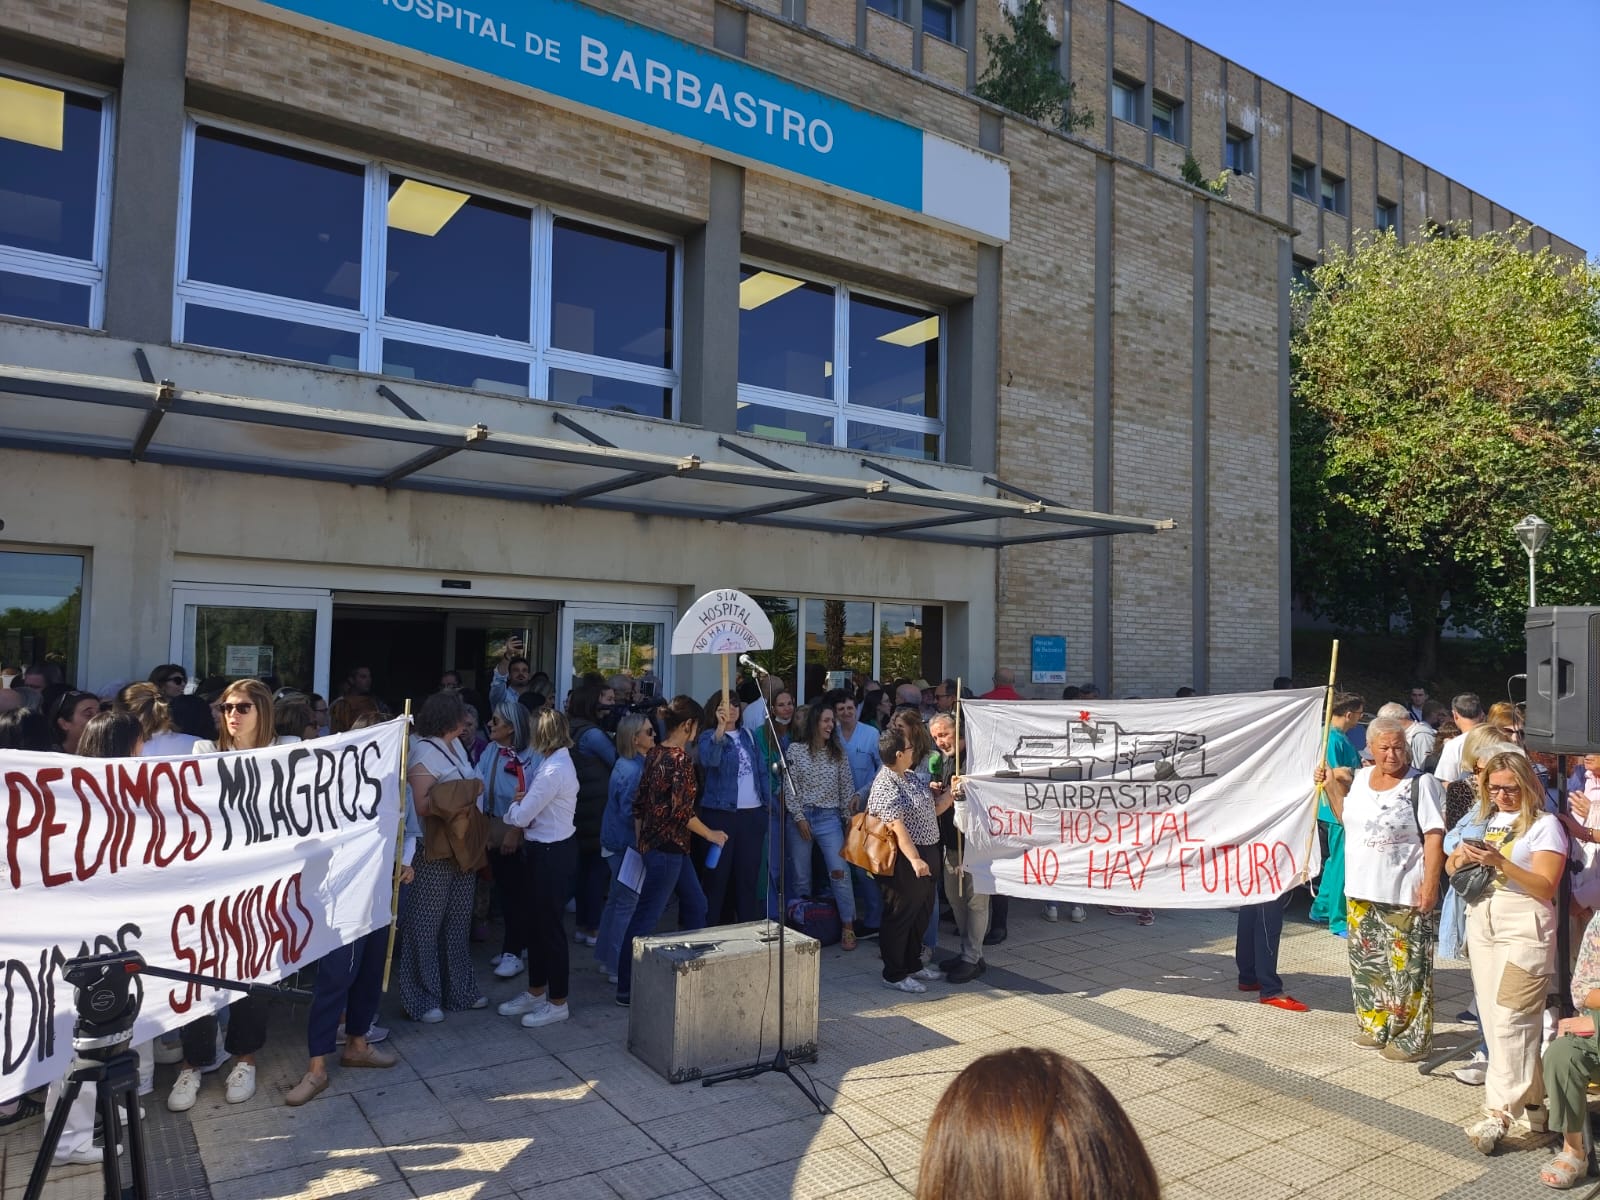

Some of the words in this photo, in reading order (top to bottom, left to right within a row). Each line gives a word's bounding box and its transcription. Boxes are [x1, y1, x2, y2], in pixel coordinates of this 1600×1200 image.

[525, 32, 561, 63] DE
[580, 35, 834, 154] BARBASTRO
[699, 603, 751, 626] HOSPITAL
[716, 592, 738, 601] SIN
[696, 637, 708, 650] NO
[708, 623, 725, 638] HAY
[730, 623, 756, 647] FUTURO
[5, 760, 212, 889] PEDIMOS
[217, 740, 382, 851] MILAGROS
[1024, 782, 1193, 811] BARBASTRO
[988, 806, 1033, 837] SIN
[1060, 810, 1205, 846] HOSPITAL
[1023, 848, 1059, 887] NO
[1087, 849, 1154, 890] HAY
[168, 872, 313, 1014] SANIDAD
